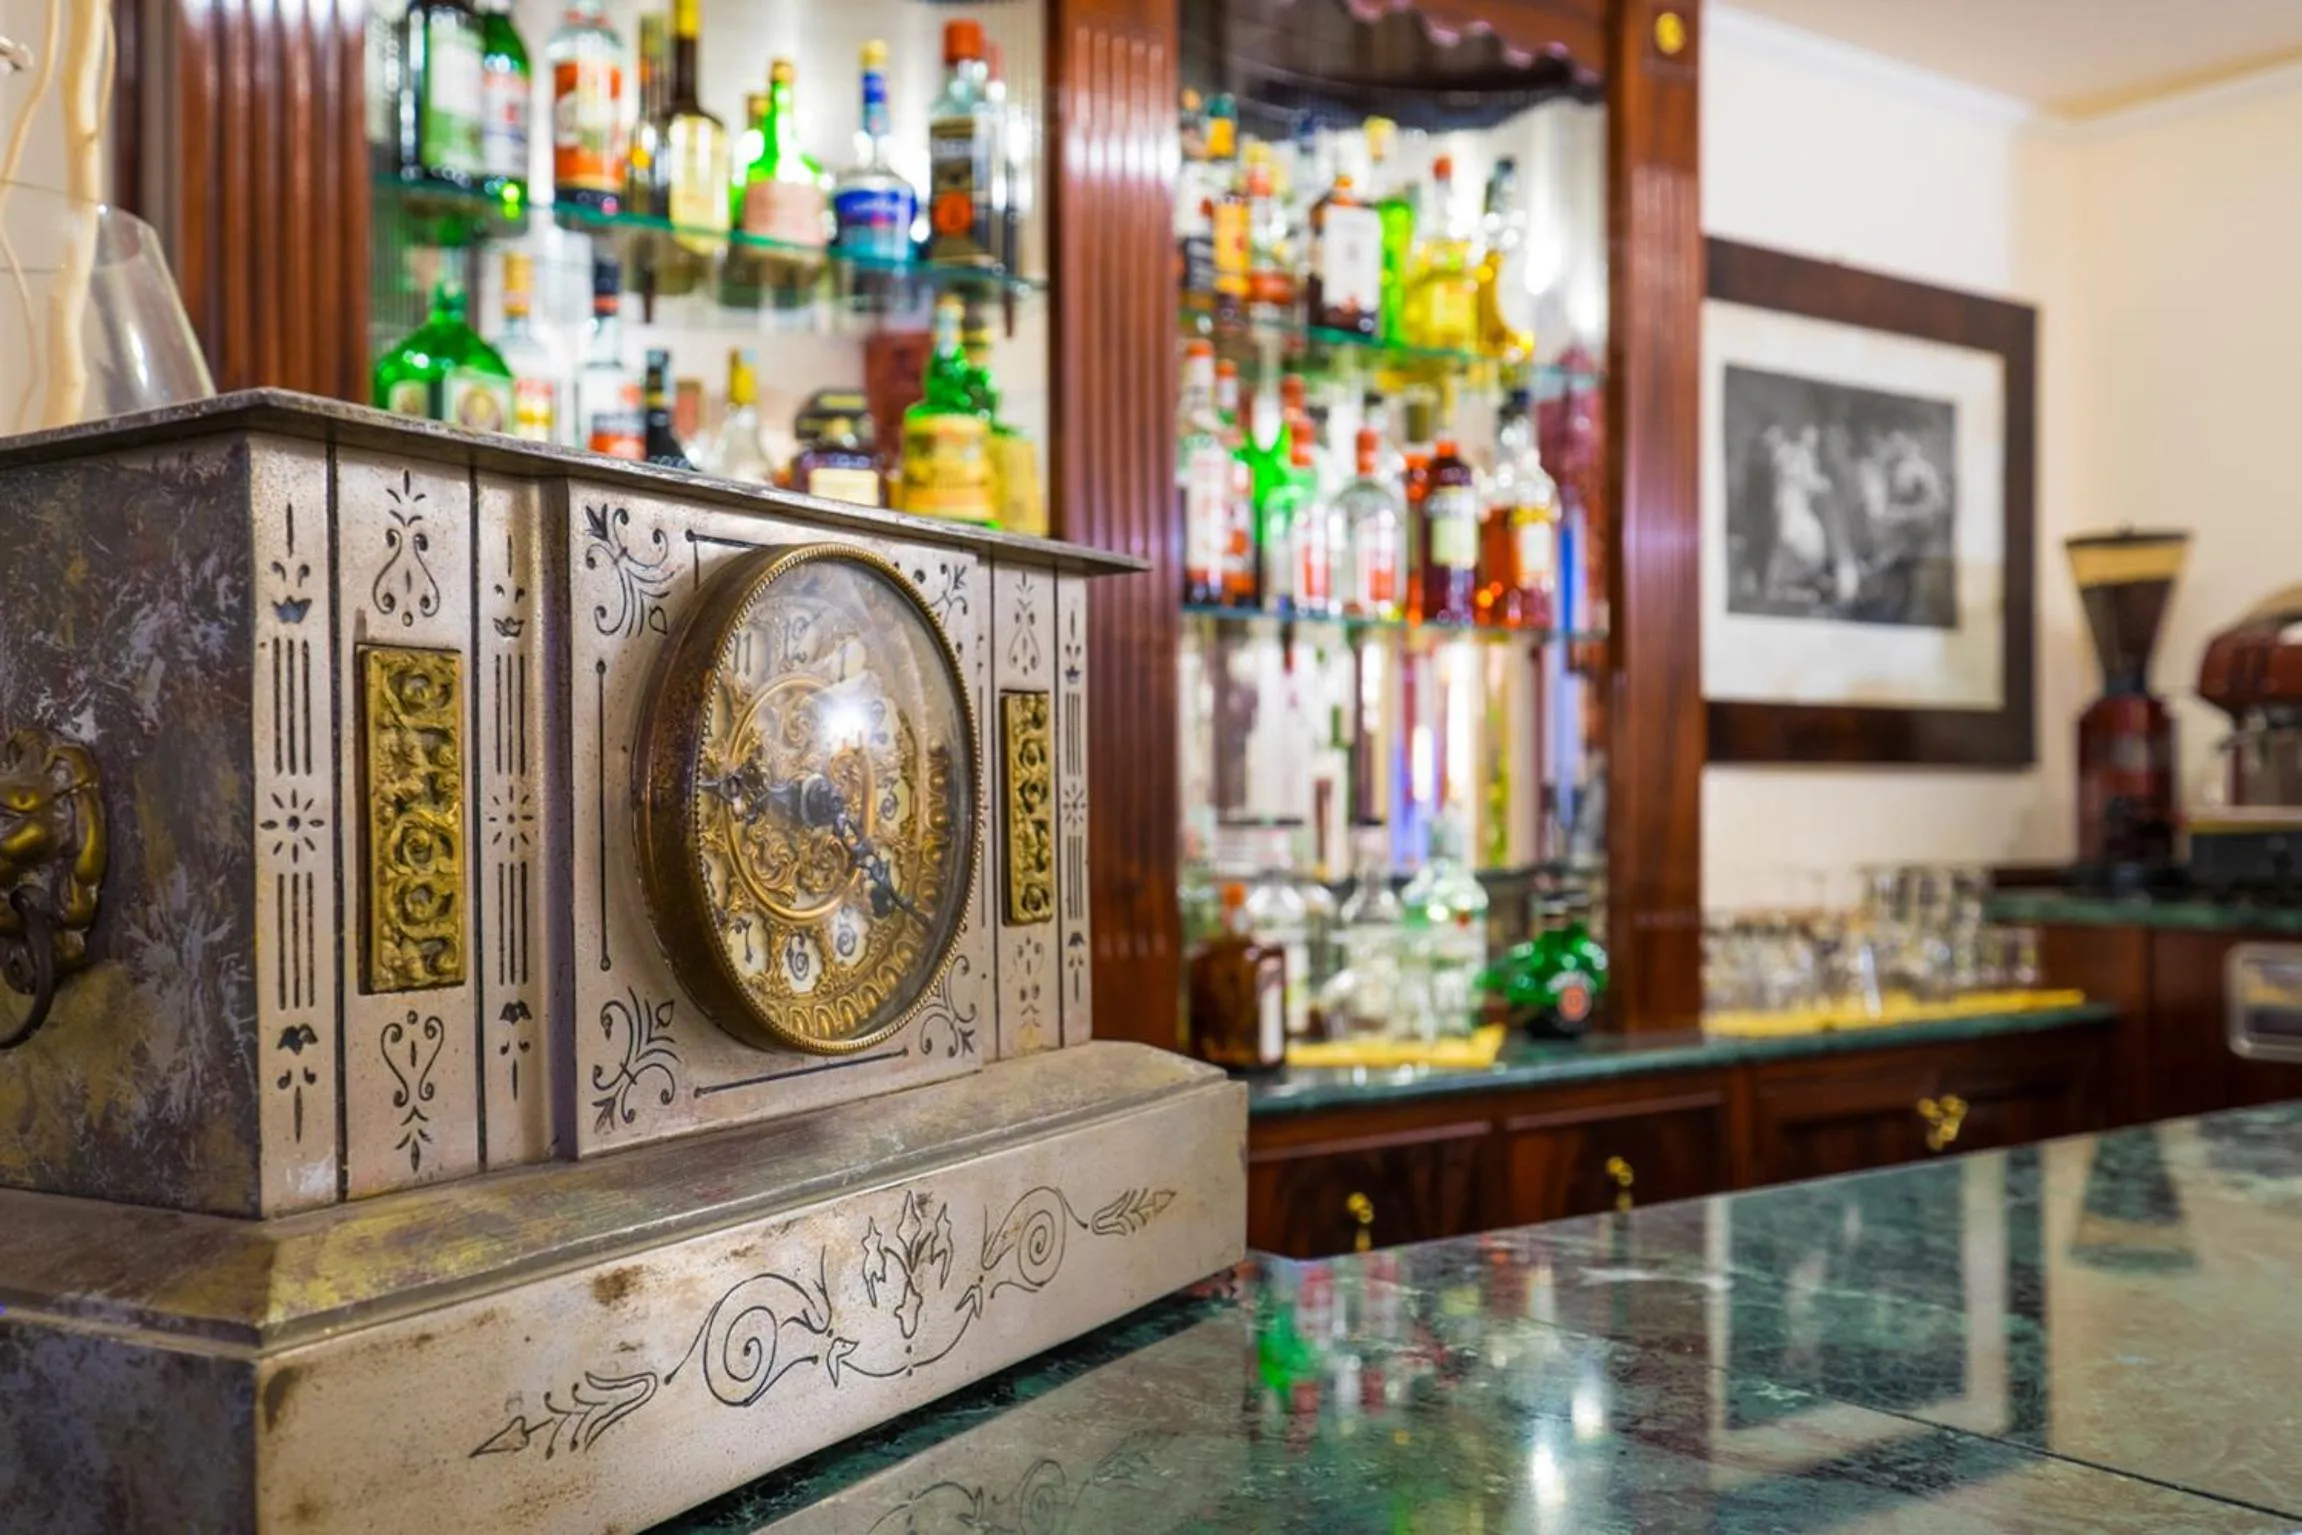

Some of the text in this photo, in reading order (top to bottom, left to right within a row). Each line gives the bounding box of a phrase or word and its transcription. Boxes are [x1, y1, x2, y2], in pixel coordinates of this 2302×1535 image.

[733, 631, 752, 677] 11
[784, 616, 809, 665] 12
[839, 643, 848, 683] 1
[870, 701, 888, 744] 2
[876, 776, 898, 820] 3
[733, 918, 752, 964] 7
[836, 903, 857, 957] 5
[786, 931, 809, 981] 6
